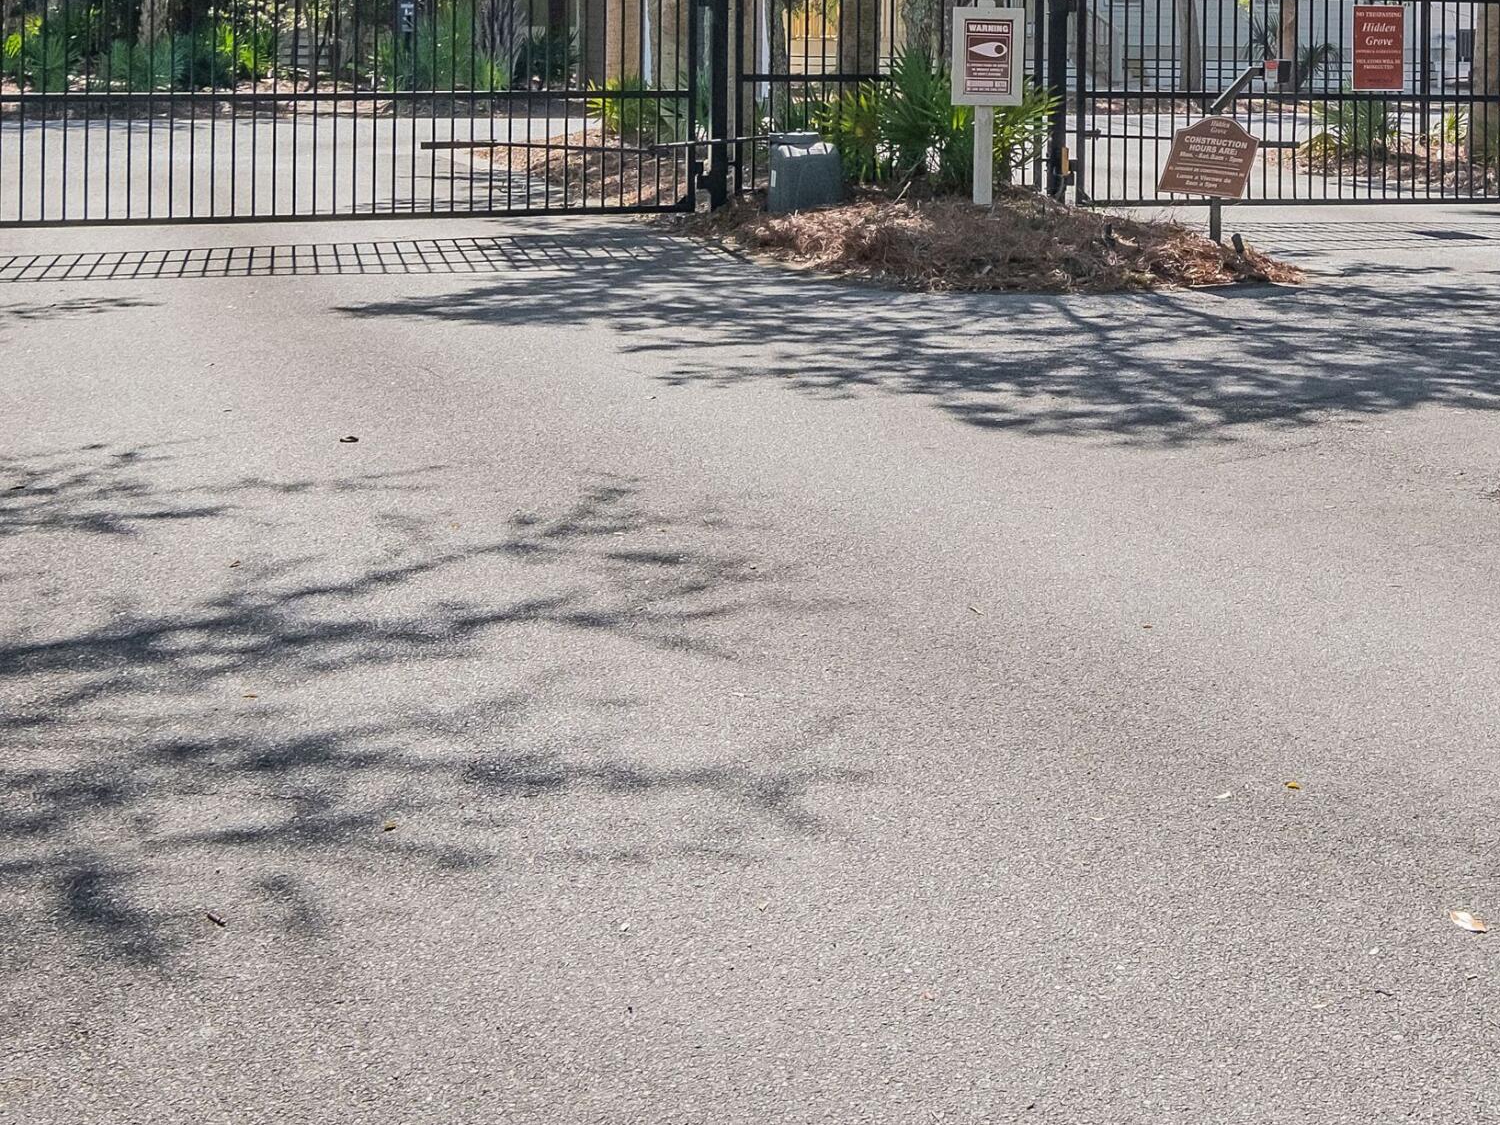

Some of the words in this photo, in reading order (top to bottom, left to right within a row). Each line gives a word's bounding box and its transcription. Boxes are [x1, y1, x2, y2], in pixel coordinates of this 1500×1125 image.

[968, 24, 1009, 33] WARNING
[1362, 22, 1395, 32] Hidden
[1365, 36, 1393, 46] Grove
[1184, 136, 1248, 149] CONSTRUCTION
[1189, 144, 1217, 153] HOURS
